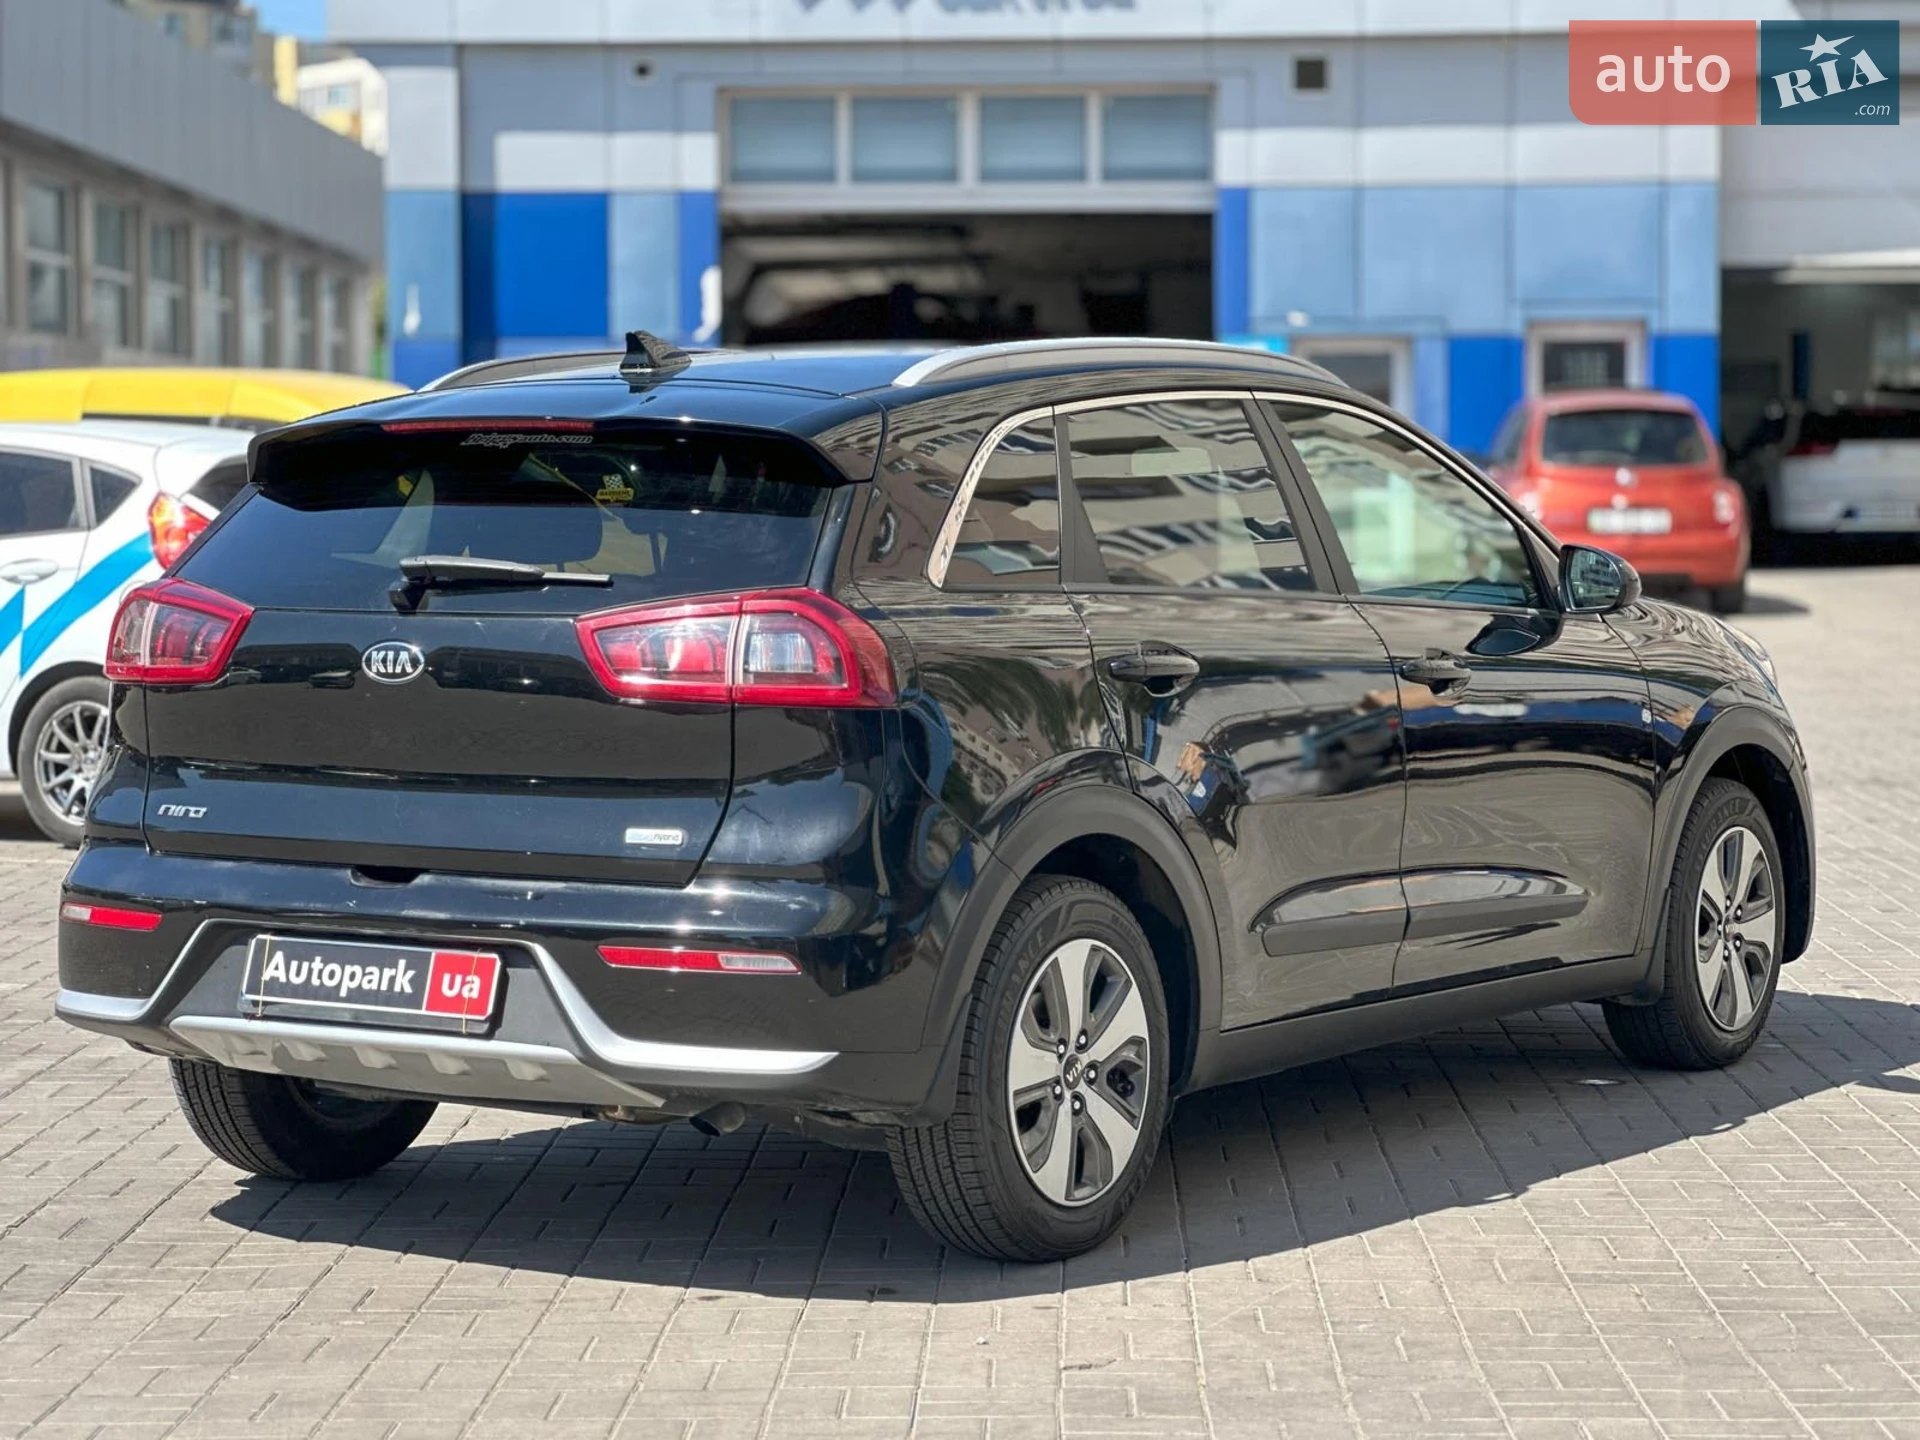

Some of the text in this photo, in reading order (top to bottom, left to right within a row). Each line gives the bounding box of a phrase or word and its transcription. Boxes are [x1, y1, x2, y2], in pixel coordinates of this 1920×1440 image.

[371, 651, 413, 673] KIA
[263, 951, 481, 999] Autopark ua
[1065, 1060, 1082, 1083] KIA
